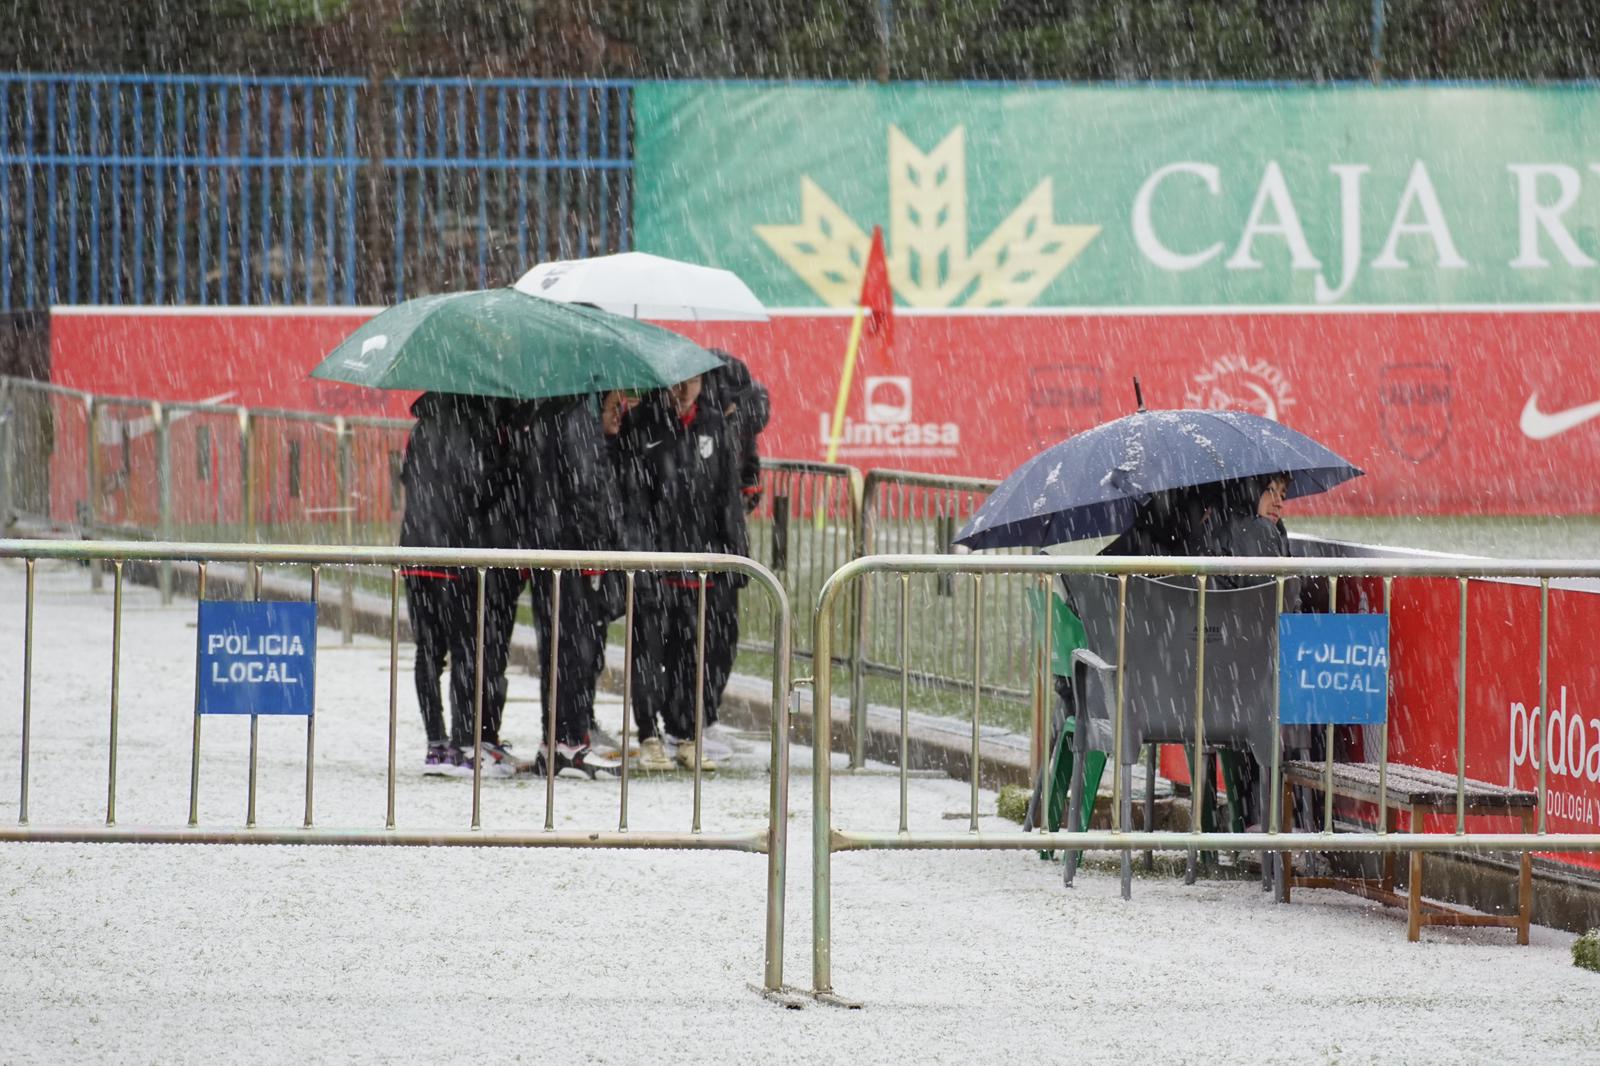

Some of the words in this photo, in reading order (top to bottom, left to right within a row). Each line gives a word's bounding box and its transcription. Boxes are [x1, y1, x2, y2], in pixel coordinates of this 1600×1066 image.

[1131, 159, 1468, 302] CAJA
[1505, 162, 1600, 268] R
[819, 411, 960, 445] Limcasa
[207, 633, 305, 656] POLICIA
[1297, 643, 1388, 668] POLICIA
[211, 662, 299, 683] LOCAL
[1301, 669, 1381, 693] LOCAL
[1533, 786, 1594, 825] PDOLOGÍA
